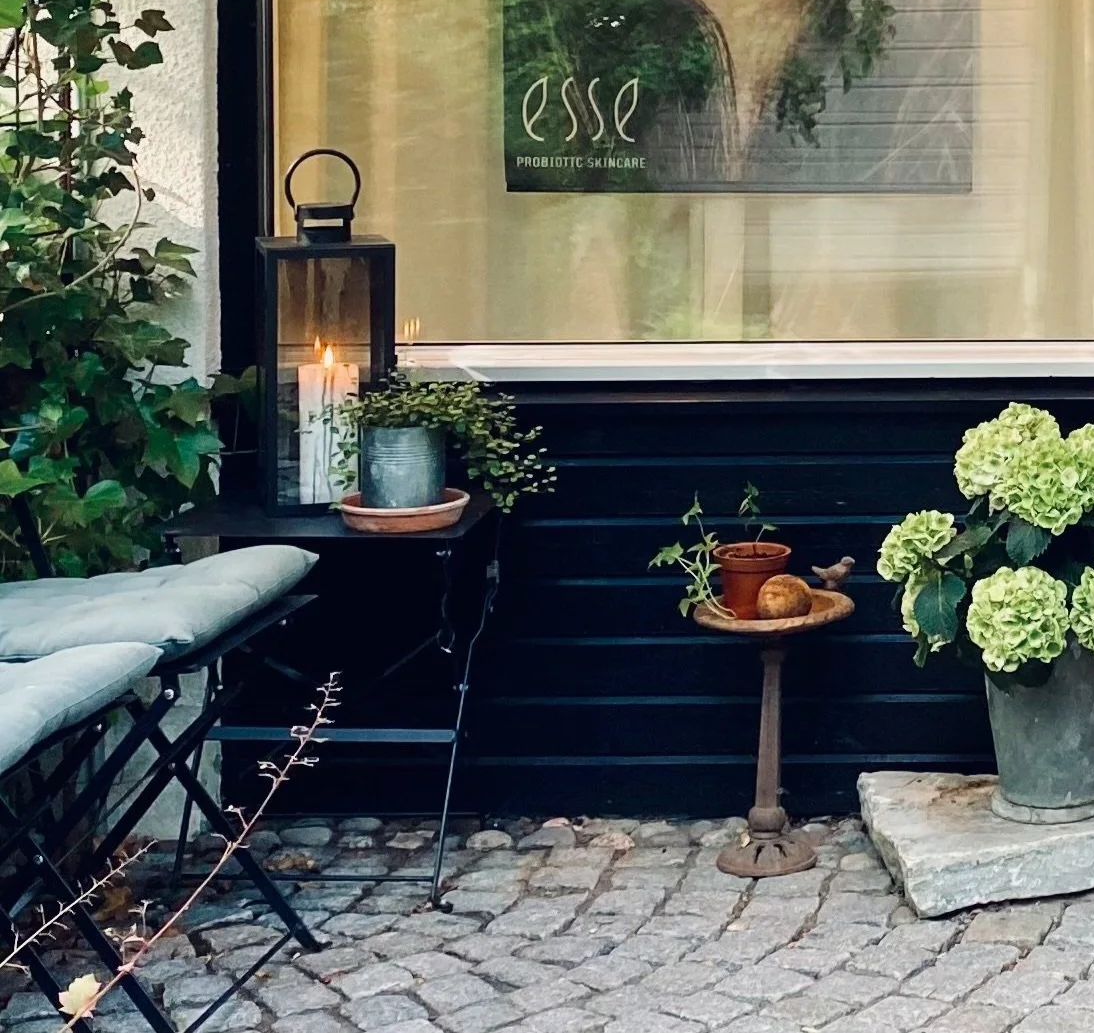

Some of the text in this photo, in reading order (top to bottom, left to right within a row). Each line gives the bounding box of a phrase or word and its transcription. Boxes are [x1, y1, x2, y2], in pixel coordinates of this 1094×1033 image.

[522, 76, 639, 143] esse
[516, 156, 646, 169] PROBIOTIC SKINCARE
